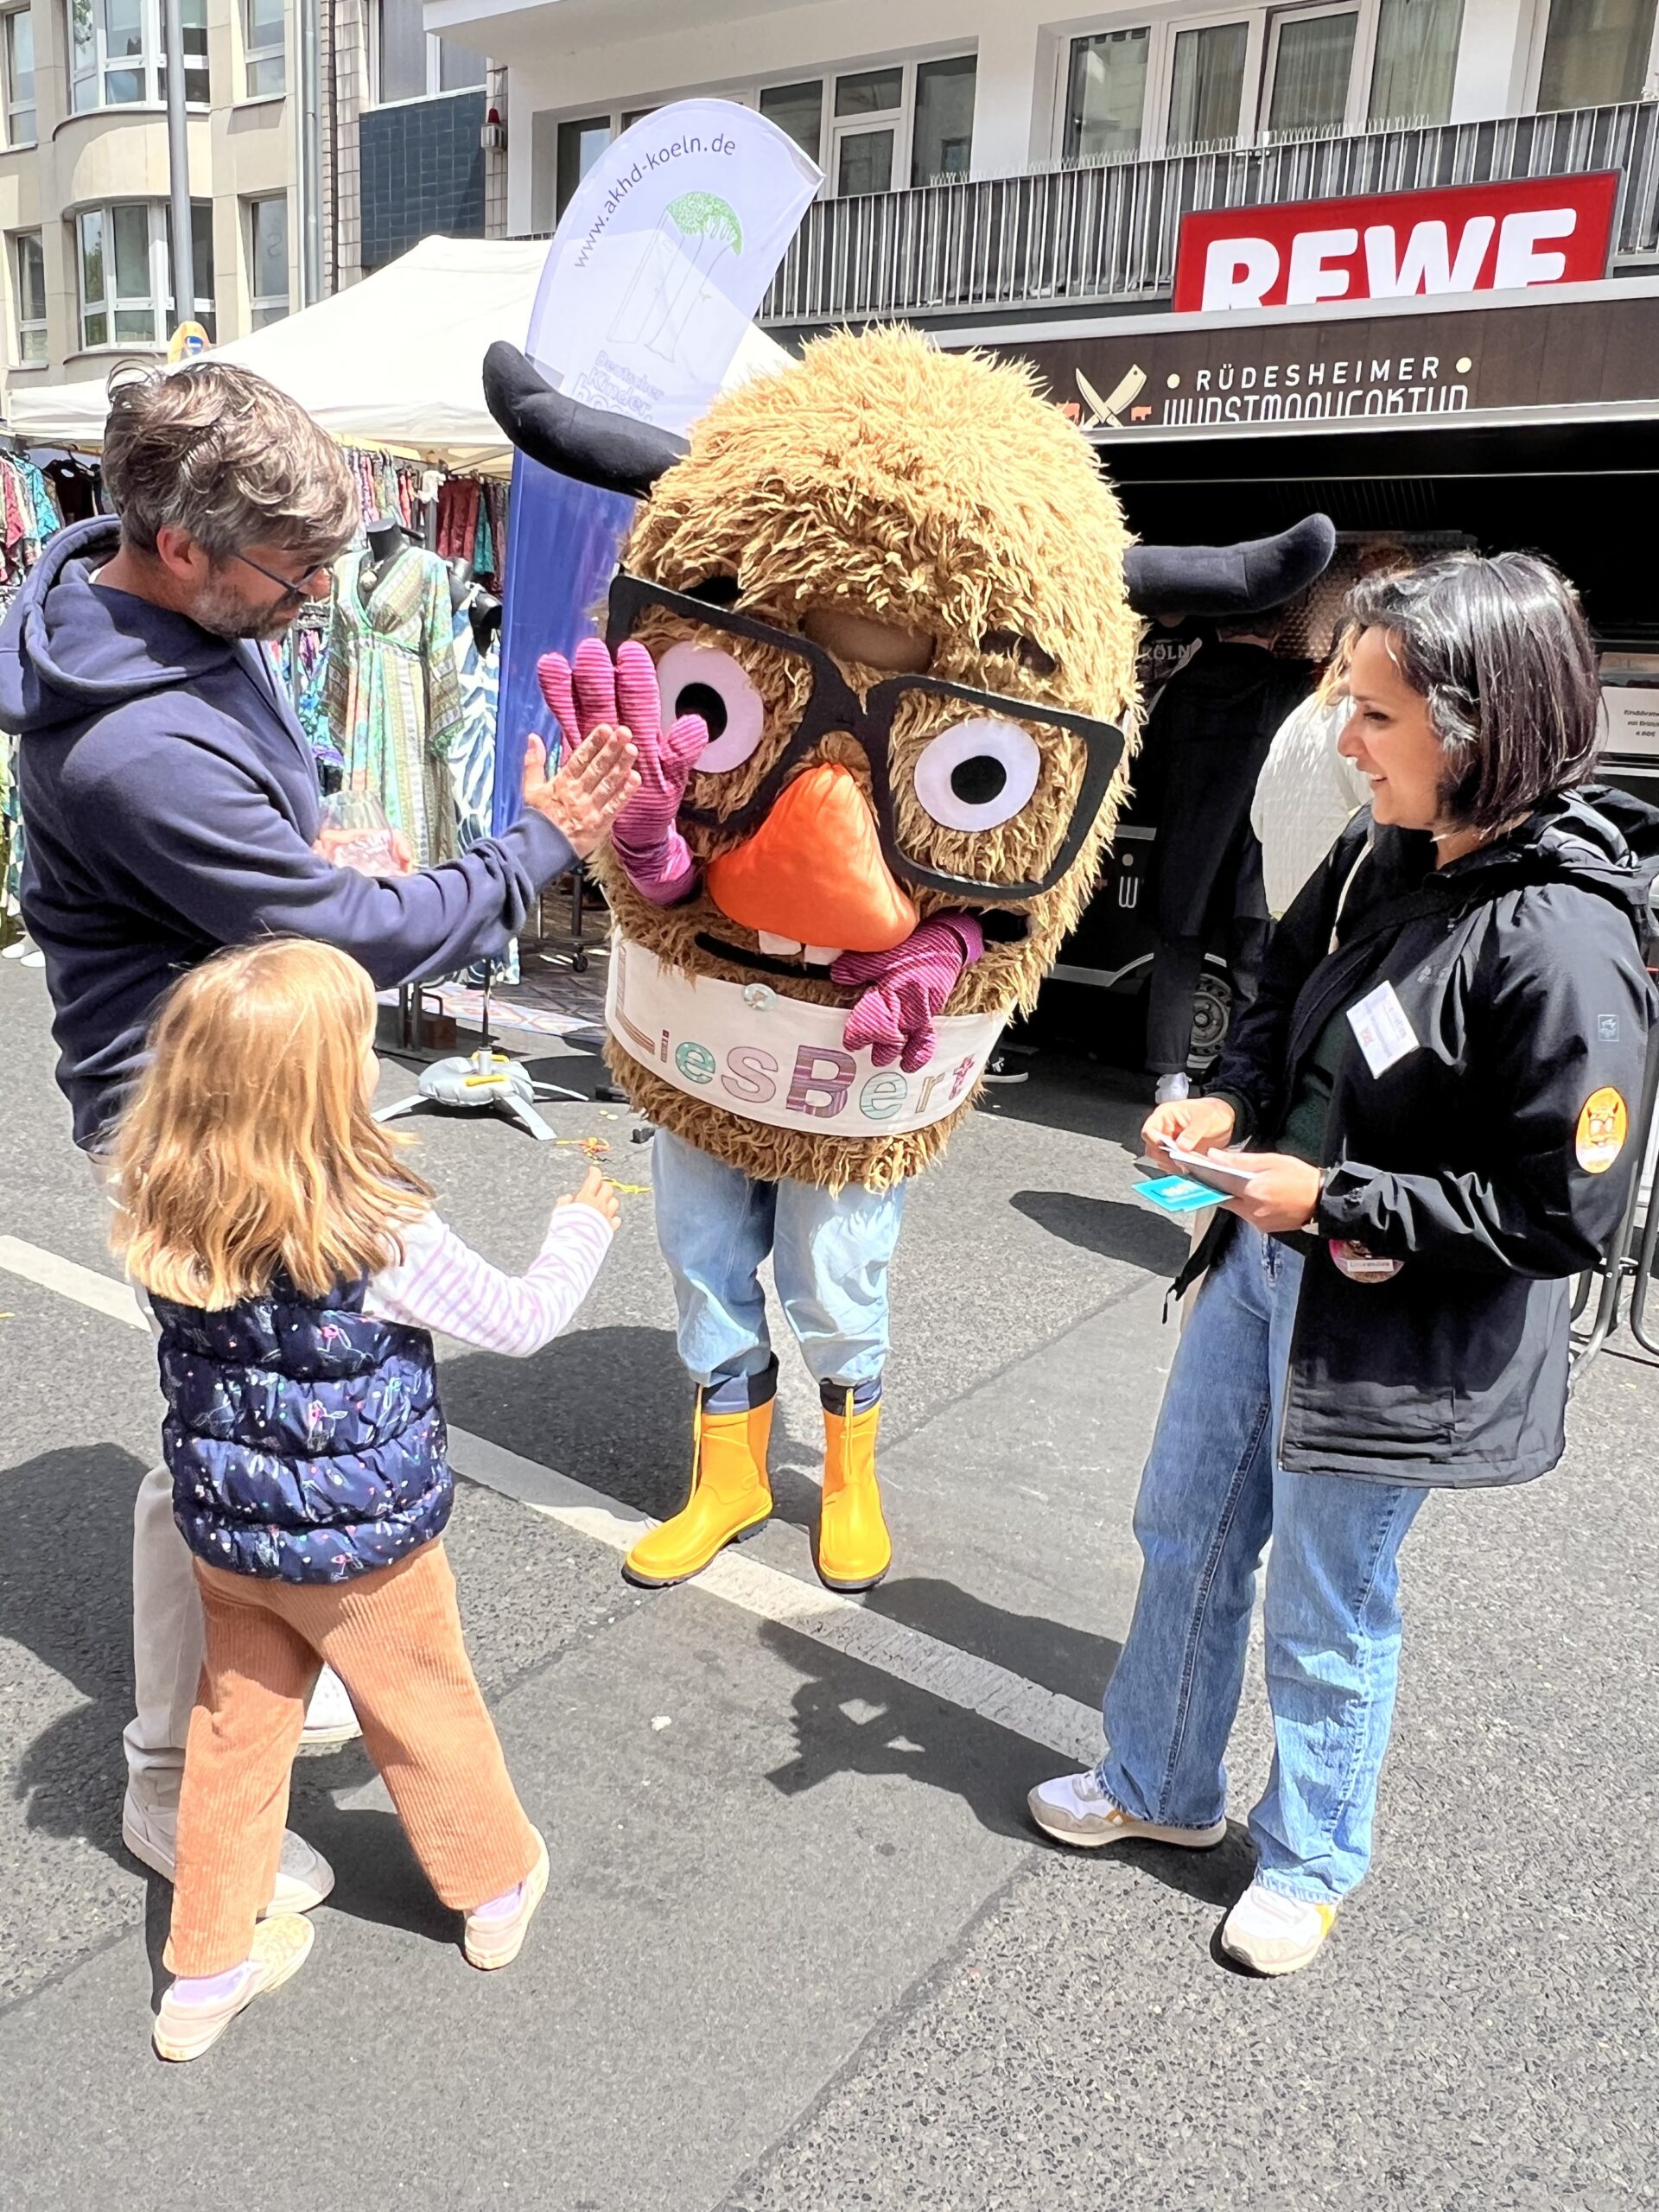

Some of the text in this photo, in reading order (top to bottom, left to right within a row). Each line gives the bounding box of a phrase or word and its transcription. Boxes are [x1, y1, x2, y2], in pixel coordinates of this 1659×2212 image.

[575, 133, 736, 269] www.akhd-koeln.de
[1201, 207, 1577, 312] REWE
[594, 349, 664, 401] Deutscher
[1196, 356, 1440, 391] RÜDESHEIMER
[614, 945, 976, 1120] LiesBert
